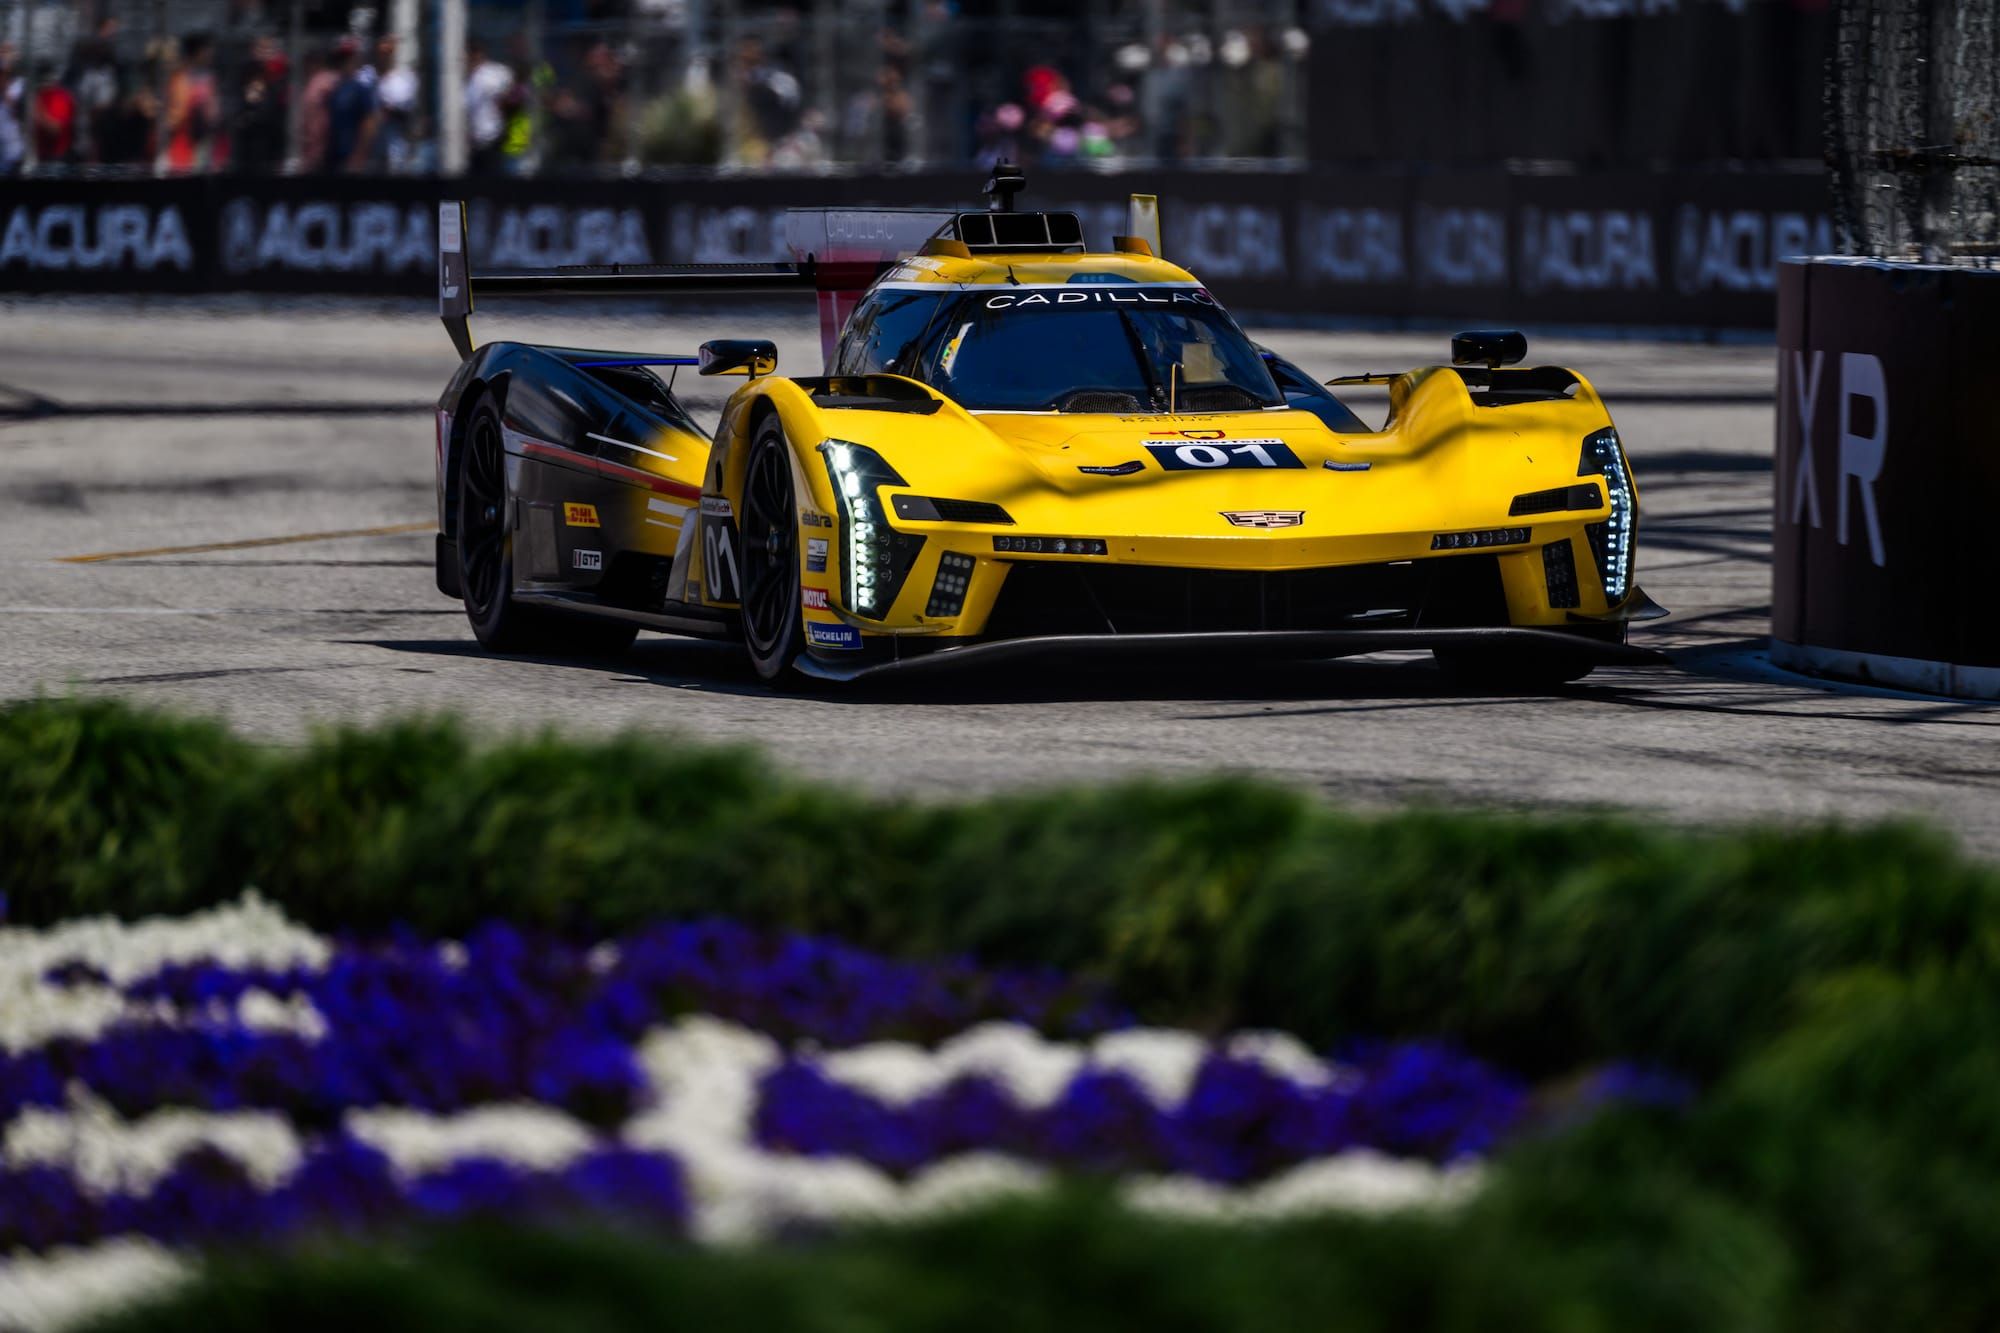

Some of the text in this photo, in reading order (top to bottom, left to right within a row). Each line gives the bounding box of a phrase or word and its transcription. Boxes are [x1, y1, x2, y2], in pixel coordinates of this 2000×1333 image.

[2, 205, 194, 269] ACURA
[256, 203, 437, 272] ACURA
[827, 212, 894, 240] CADILLAC
[985, 288, 1215, 310] CADILLAC
[1175, 443, 1278, 468] 01
[569, 506, 599, 523] DHL
[582, 553, 600, 566] GTP
[705, 524, 741, 600] 01
[813, 629, 853, 642] MICHELIN
